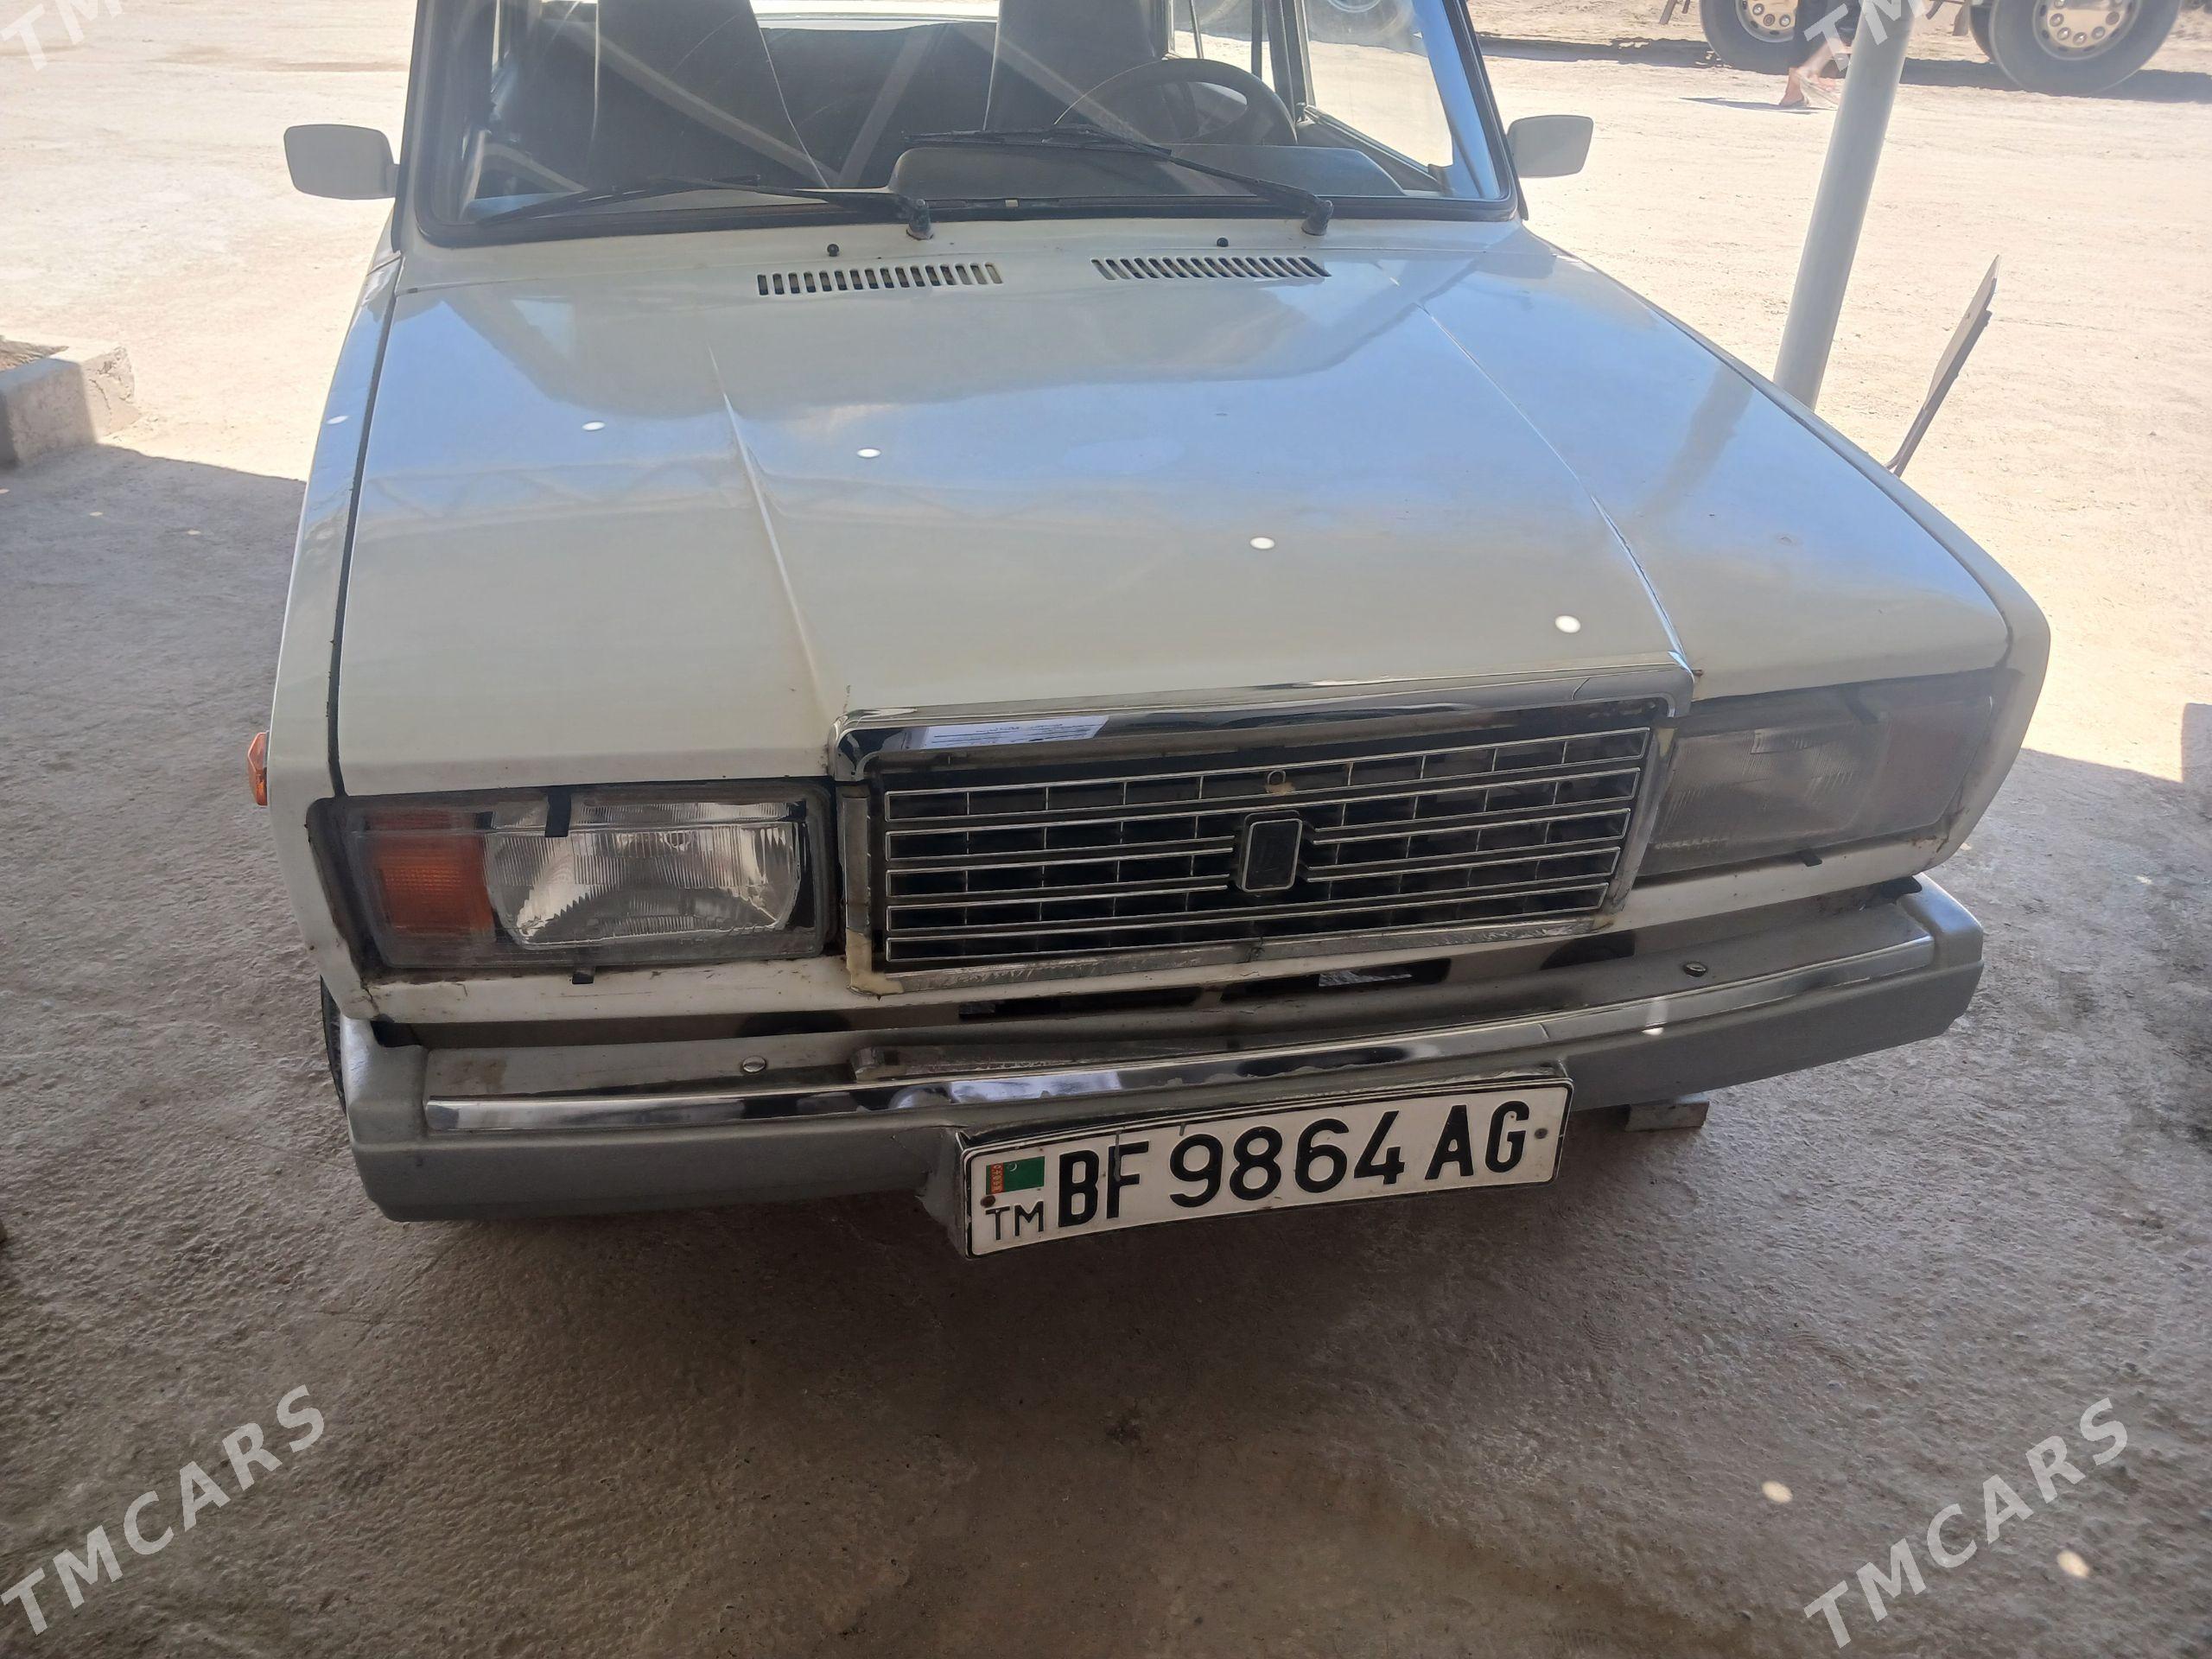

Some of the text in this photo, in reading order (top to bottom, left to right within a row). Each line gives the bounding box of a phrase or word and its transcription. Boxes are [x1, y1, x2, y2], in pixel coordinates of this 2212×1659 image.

[1058, 1100, 1530, 1228] BF 9864 AG
[985, 1200, 1045, 1241] TM
